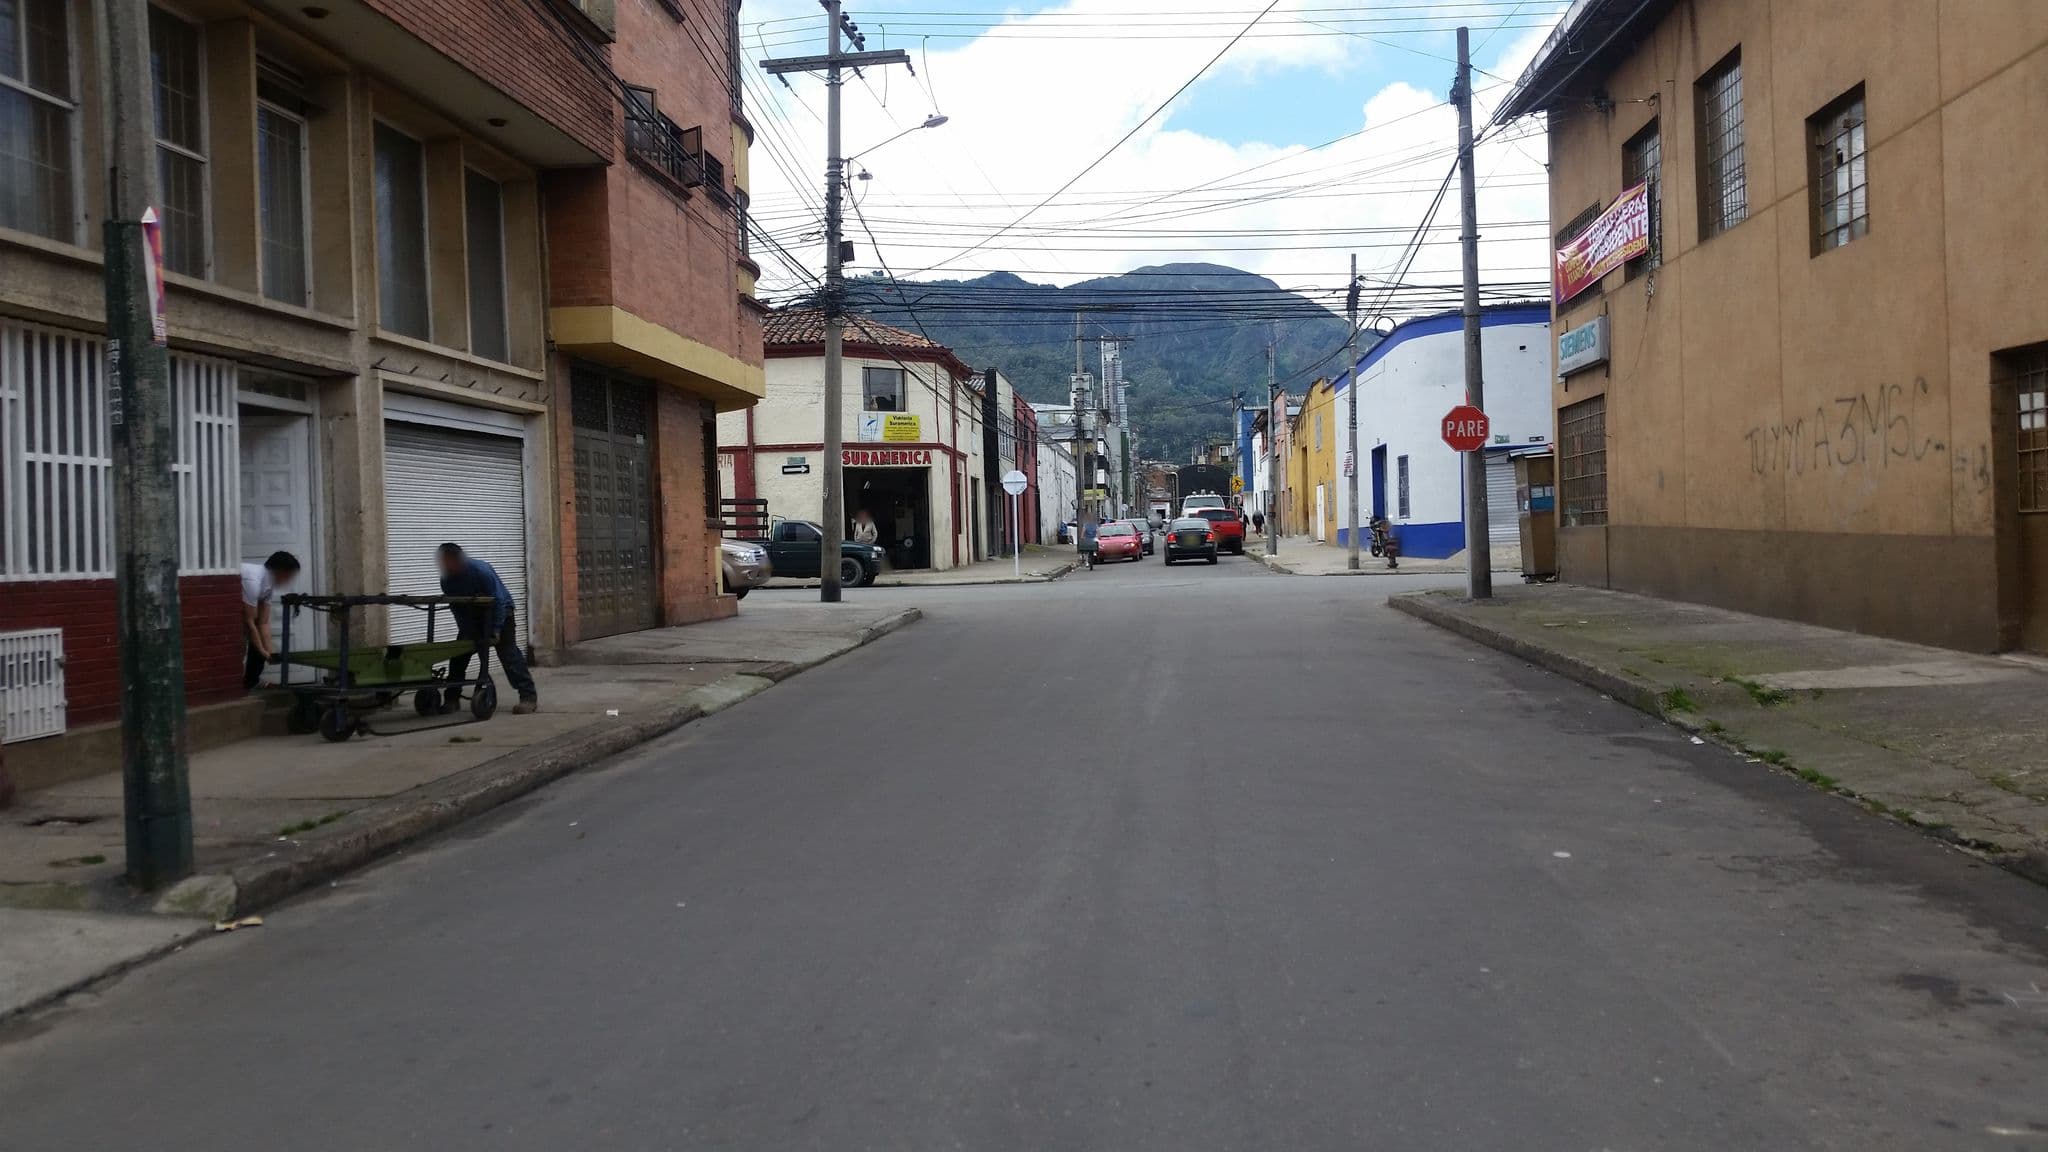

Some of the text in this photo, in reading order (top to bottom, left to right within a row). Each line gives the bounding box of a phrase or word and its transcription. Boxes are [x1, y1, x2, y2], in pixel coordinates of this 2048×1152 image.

[1560, 323, 1596, 360] SIEMENS
[1446, 420, 1485, 438] PARE
[842, 450, 932, 466] SURAMERICA
